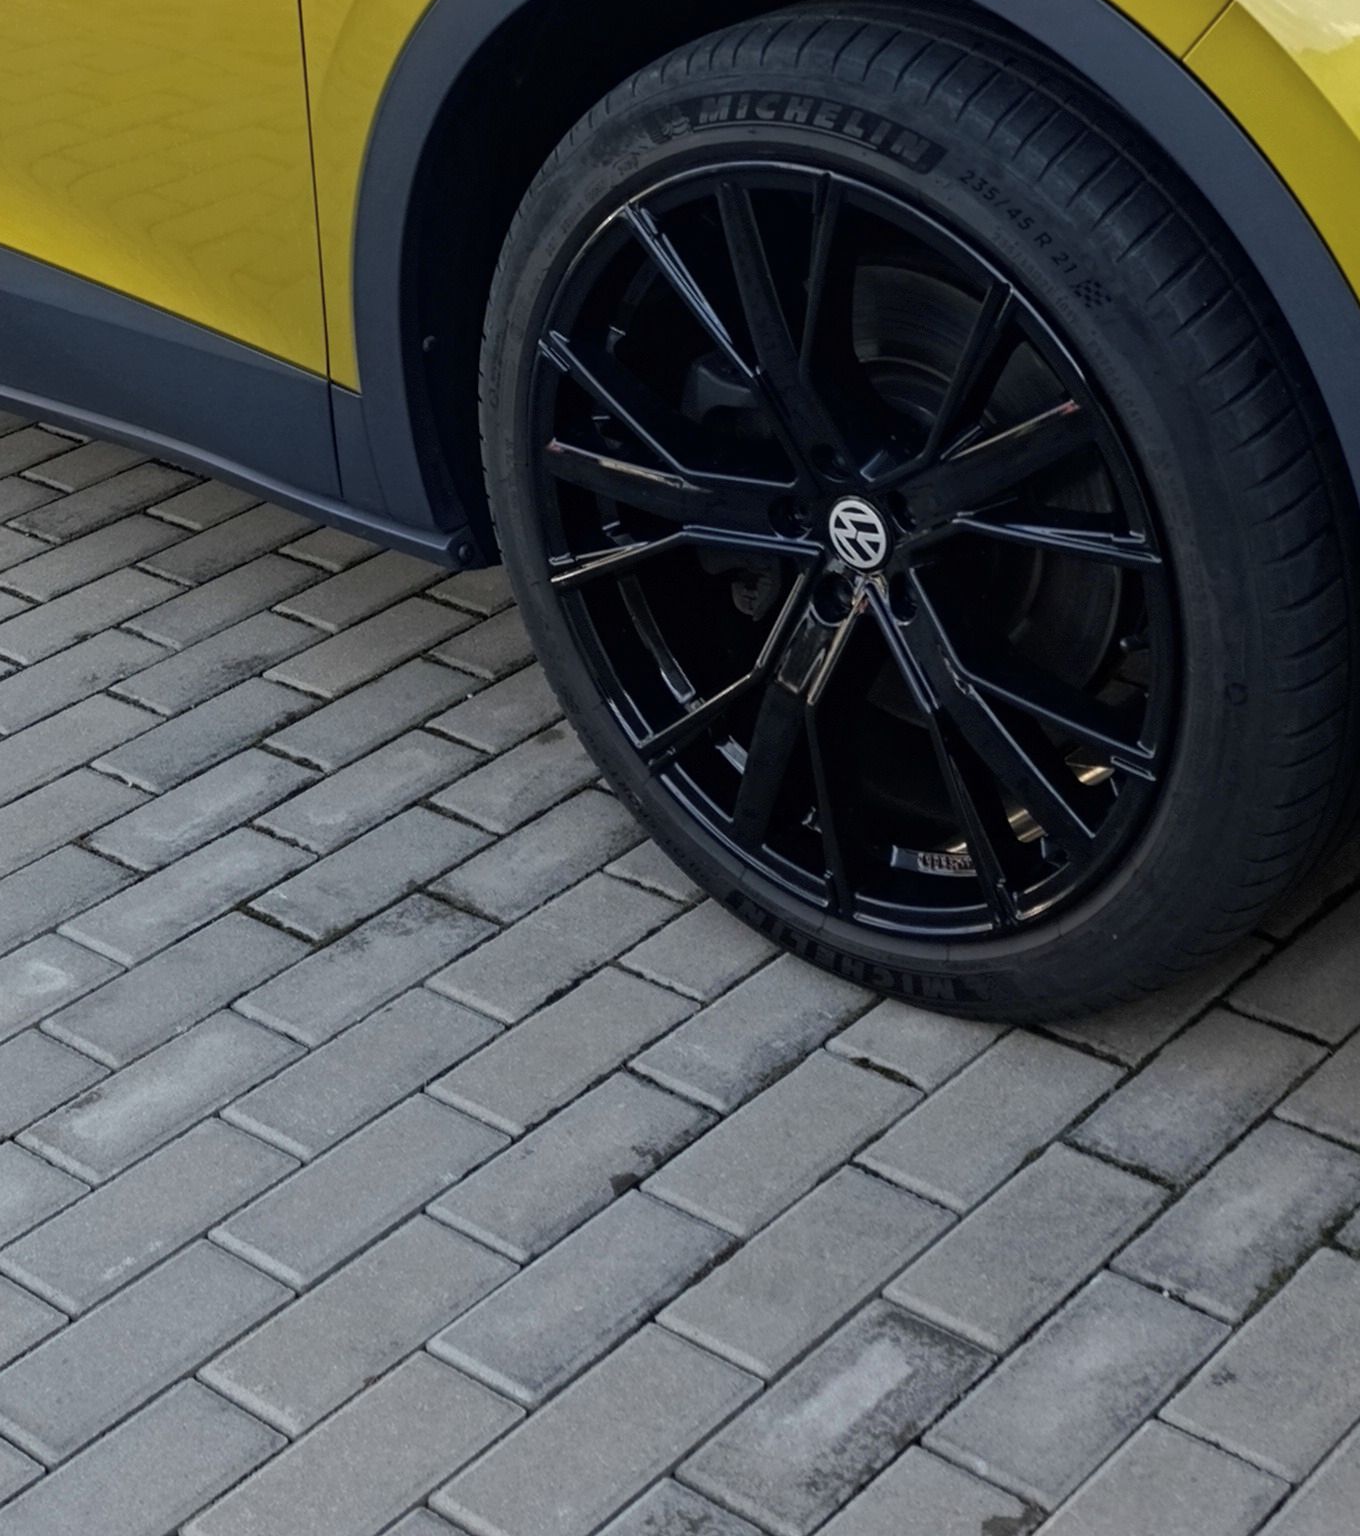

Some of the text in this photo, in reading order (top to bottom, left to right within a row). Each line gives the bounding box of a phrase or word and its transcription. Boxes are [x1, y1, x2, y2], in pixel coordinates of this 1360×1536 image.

[698, 94, 932, 164] MICHELIN
[958, 170, 1078, 275] 235/45 R 21
